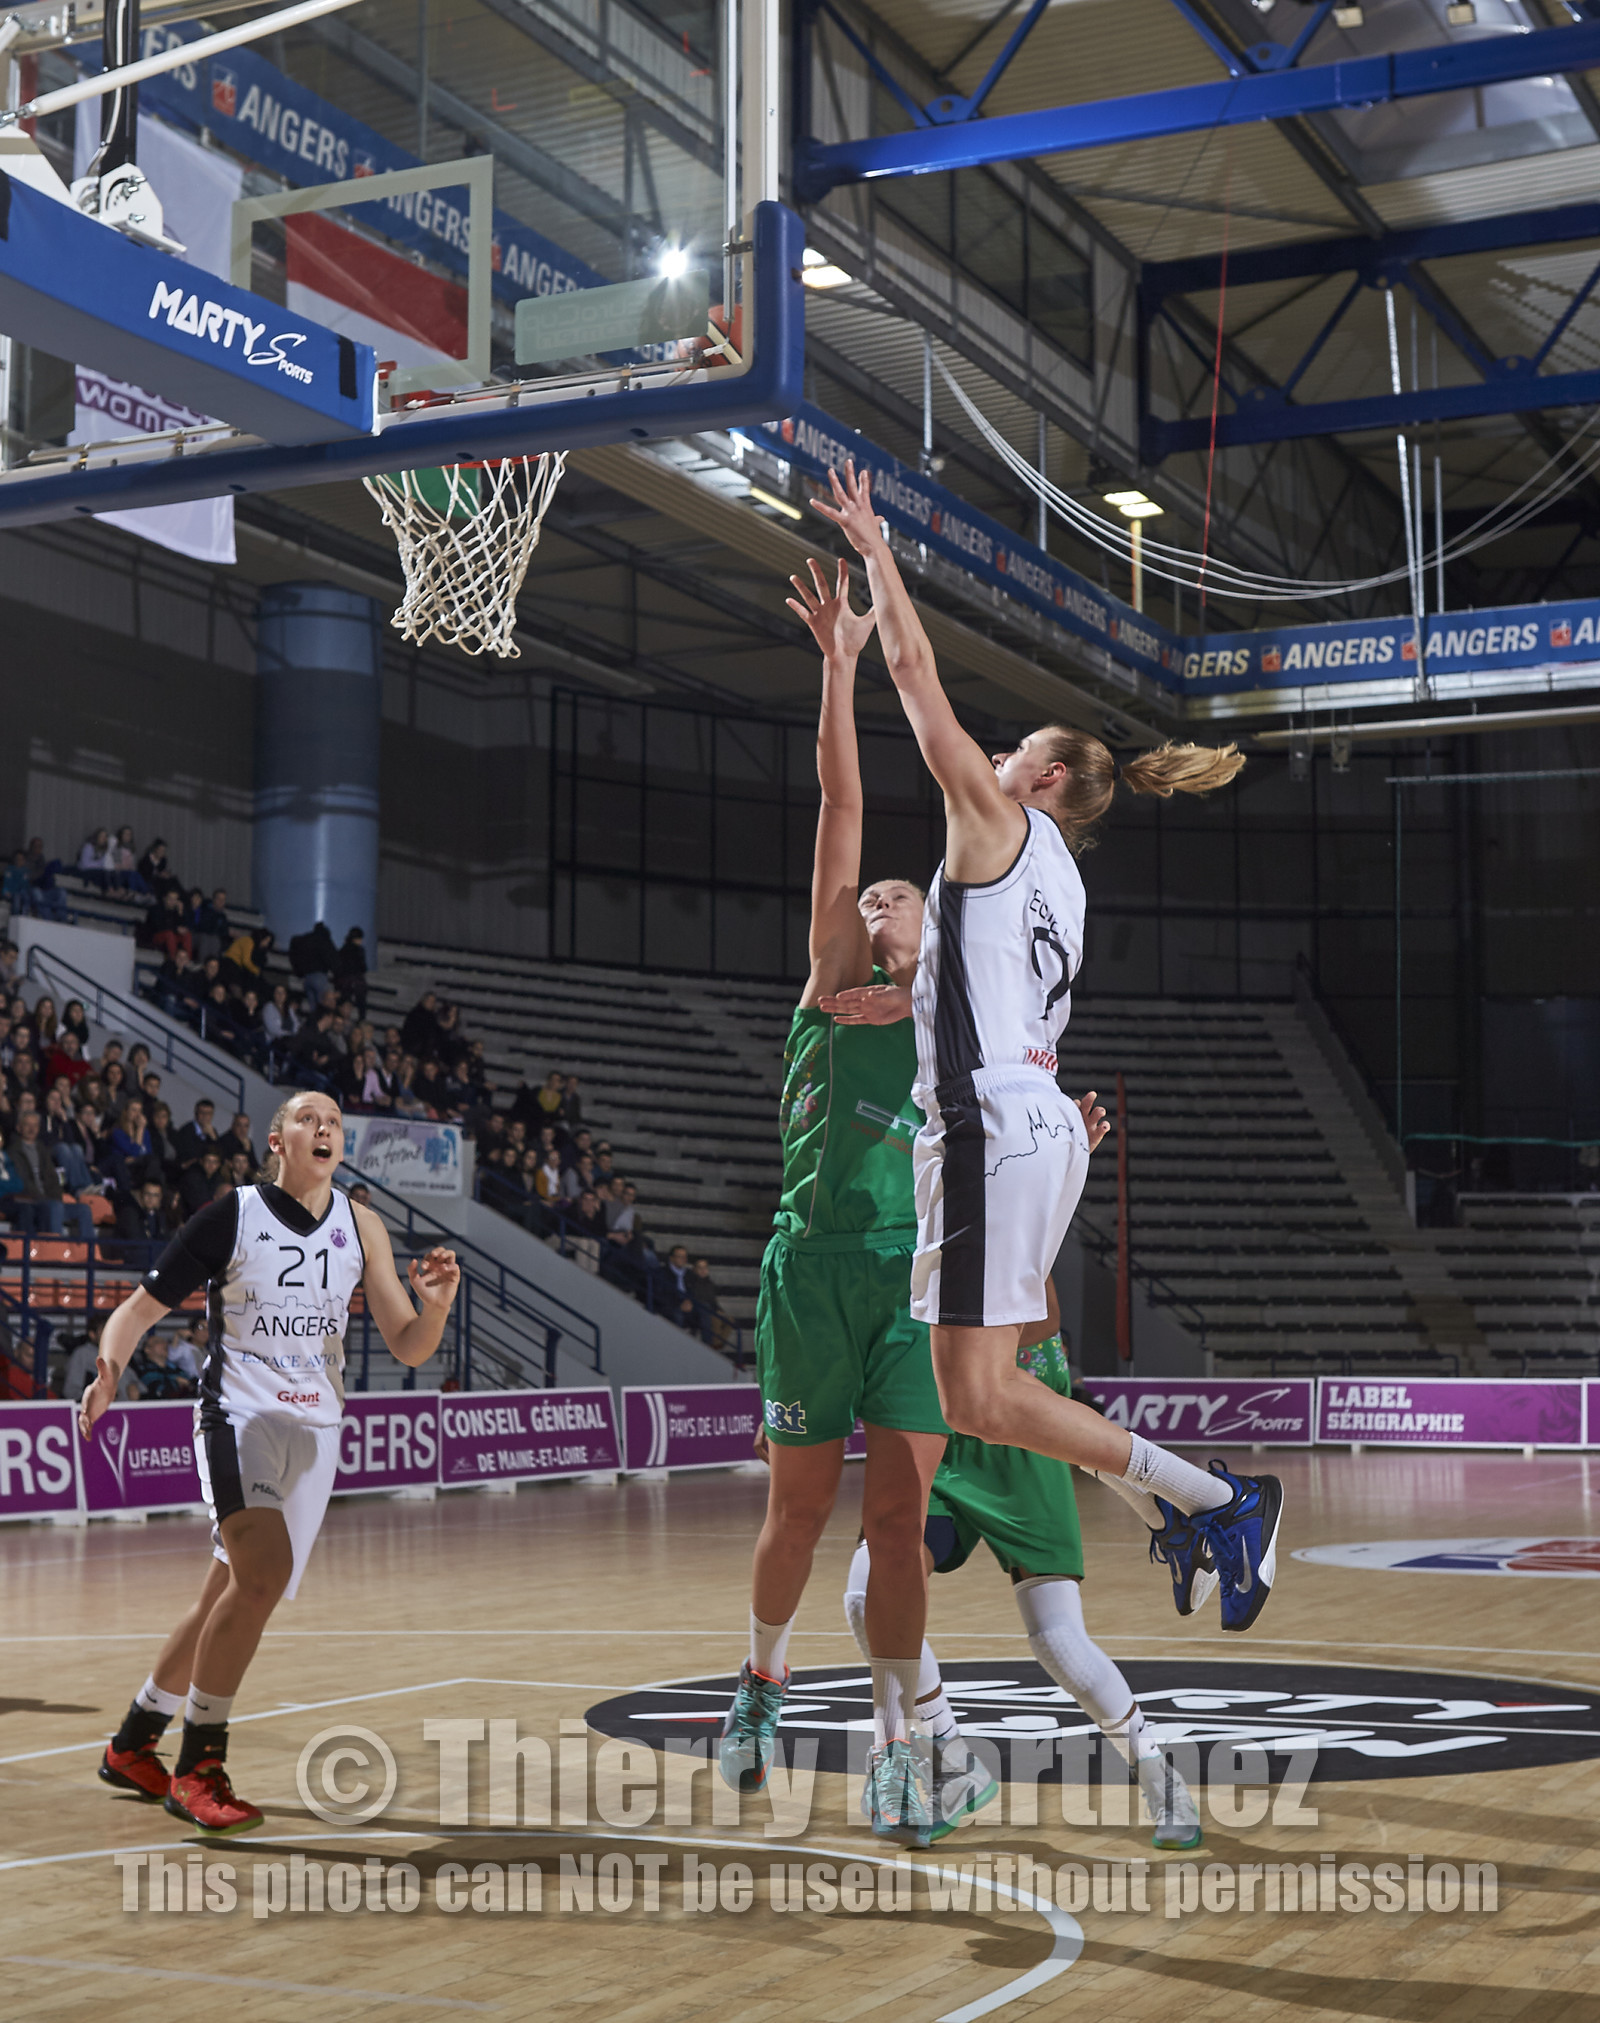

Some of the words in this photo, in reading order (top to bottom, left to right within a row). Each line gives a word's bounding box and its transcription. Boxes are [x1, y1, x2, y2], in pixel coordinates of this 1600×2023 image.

[237, 83, 349, 179] ANGERS
[376, 166, 470, 254] NGERS
[148, 280, 266, 356] MARTY
[873, 469, 933, 526] ANGERS
[940, 509, 993, 564] ANGERS
[1282, 636, 1396, 672] ANGERS
[1424, 622, 1539, 659] ANGERS
[277, 1245, 329, 1289] 21
[251, 1315, 338, 1337] ANGERS
[277, 1390, 320, 1404] Géant
[1094, 1394, 1229, 1431] ARTY
[1328, 1385, 1413, 1410] LABEL
[442, 1407, 527, 1439] CONSEIL
[530, 1398, 608, 1433] GÉNÉRAL
[669, 1417, 696, 1437] PAYS
[697, 1416, 712, 1436] DE
[712, 1416, 727, 1435] LA
[1326, 1408, 1465, 1433] SÉRIGRAPHIE
[0, 1425, 73, 1496] RS
[127, 1446, 192, 1470] UFAB49
[477, 1453, 496, 1472] DE
